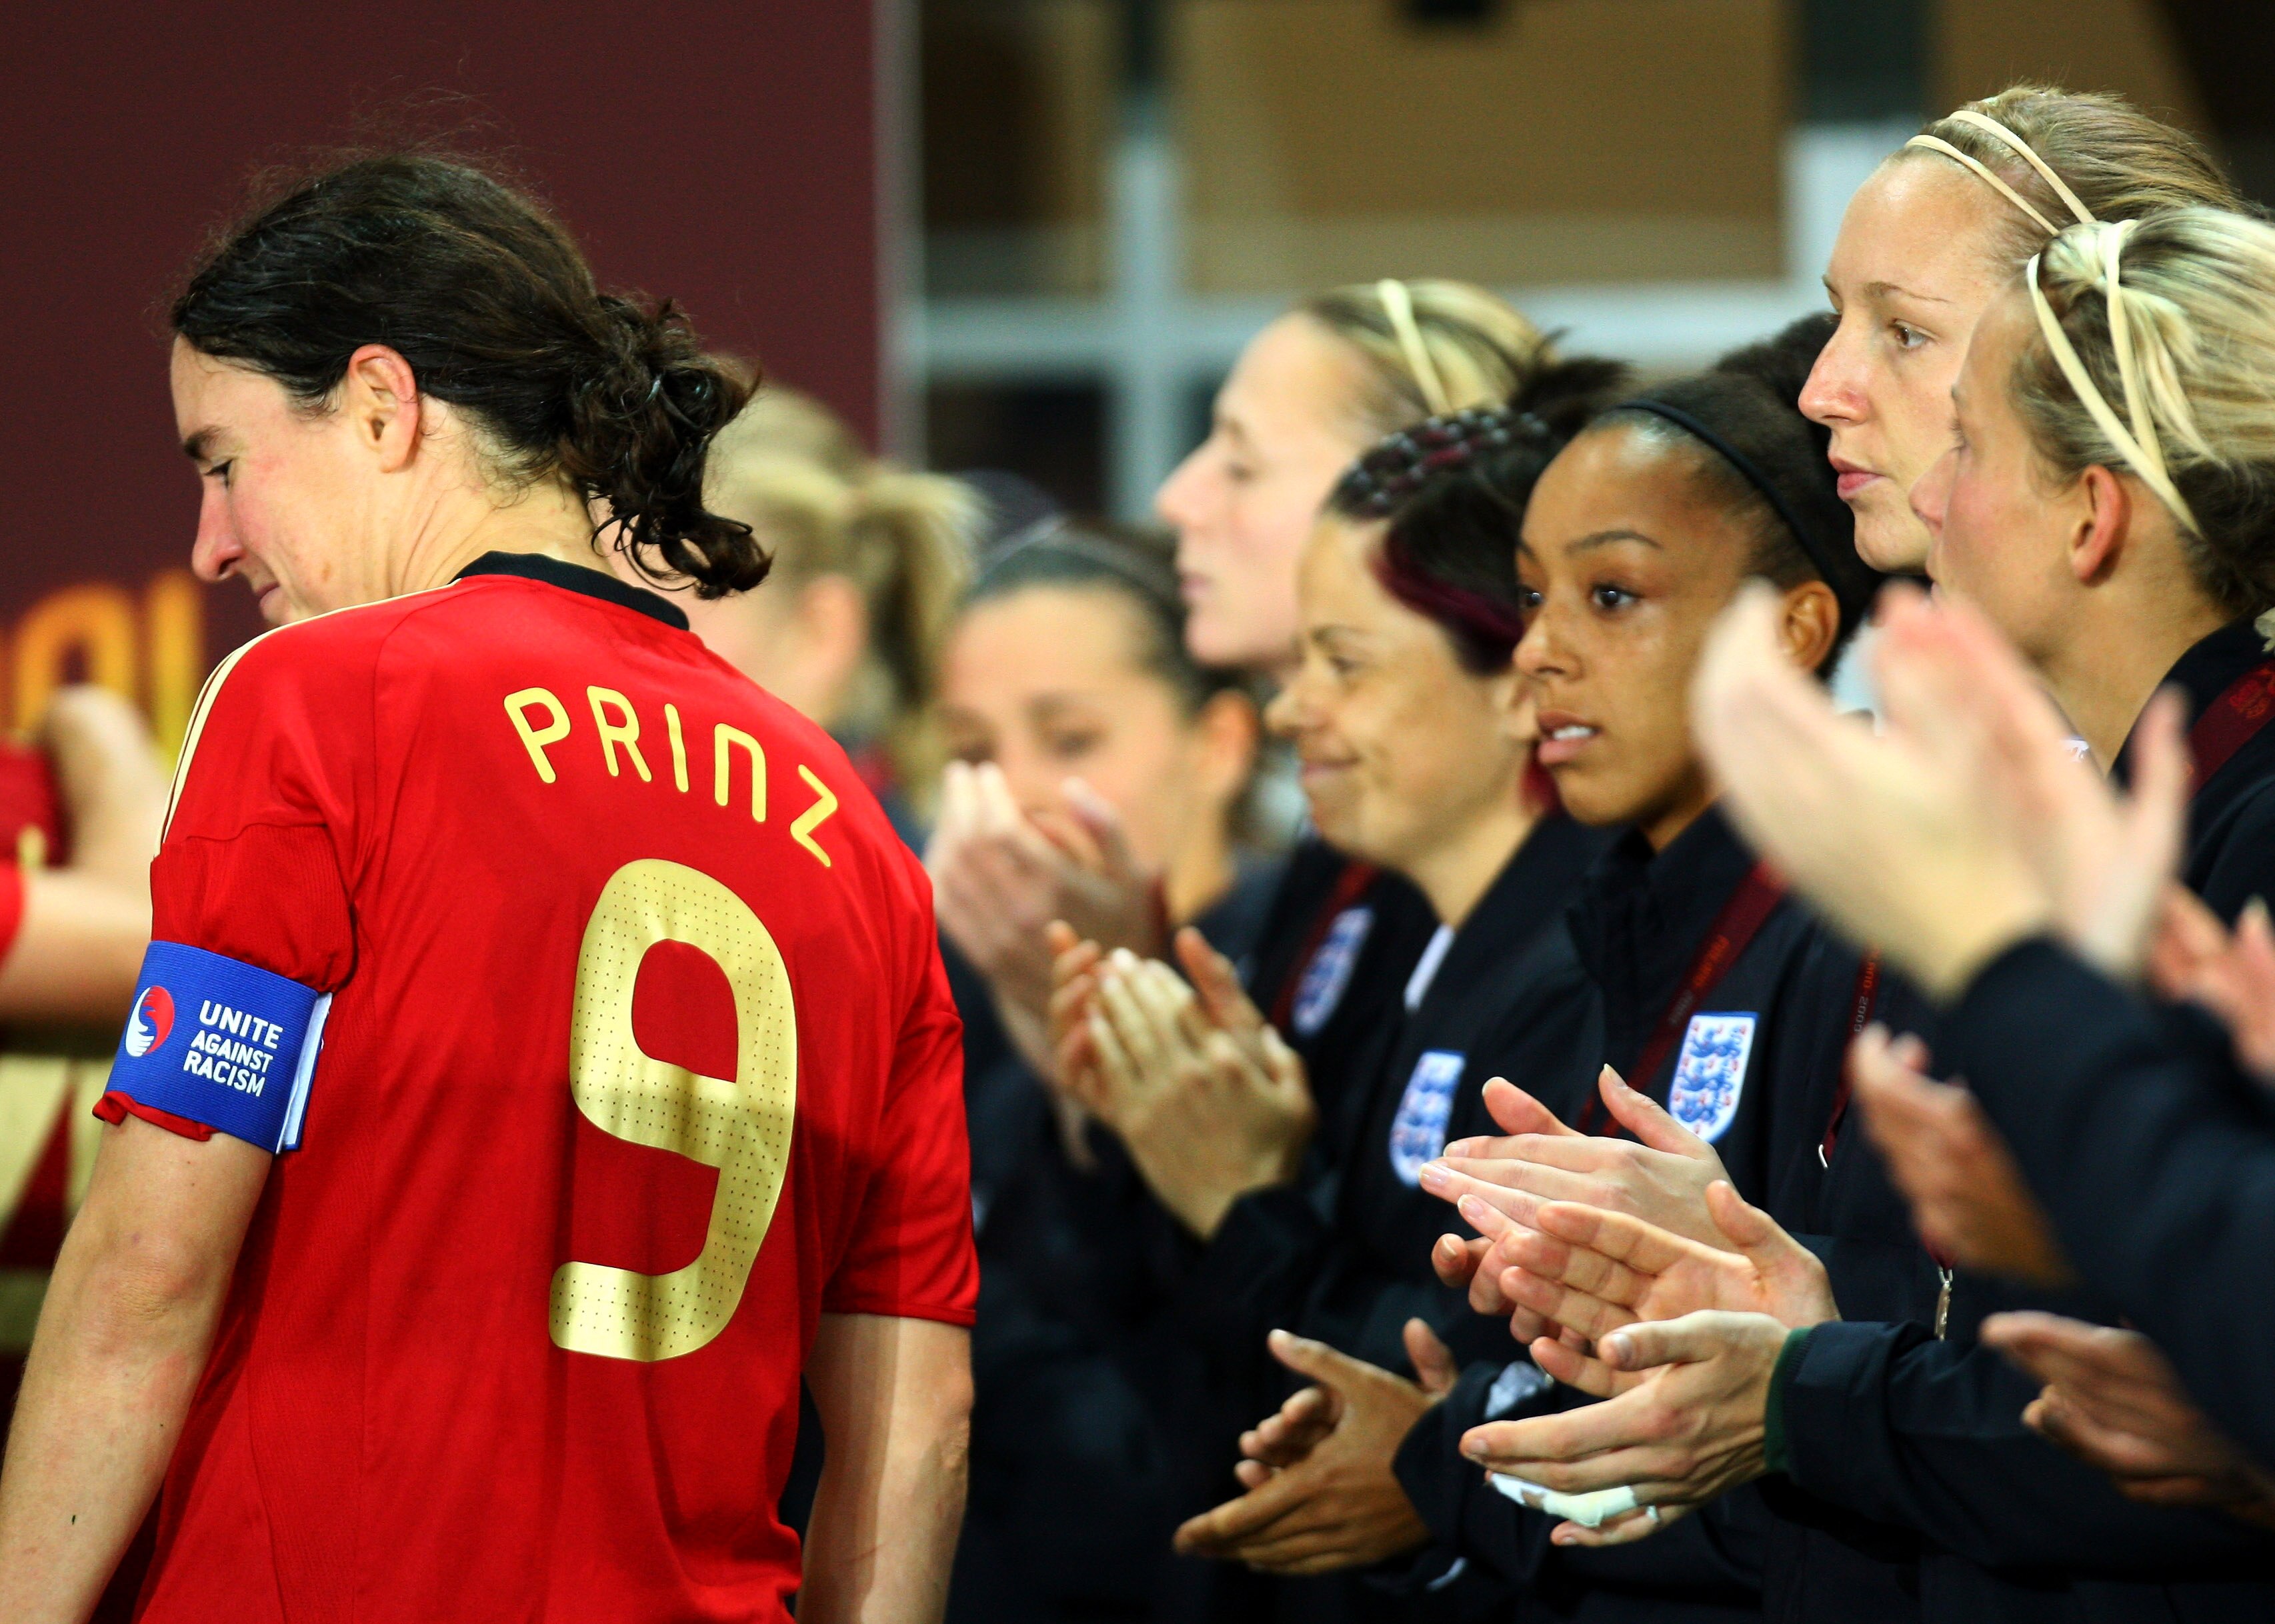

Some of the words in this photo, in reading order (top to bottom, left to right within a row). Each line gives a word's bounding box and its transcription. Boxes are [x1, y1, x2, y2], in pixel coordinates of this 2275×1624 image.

[504, 685, 838, 867] PRINZ
[199, 1000, 283, 1049] UNITE
[183, 1050, 265, 1097] RACISM
[190, 1030, 273, 1073] AGAINST
[549, 858, 797, 1362] 9
